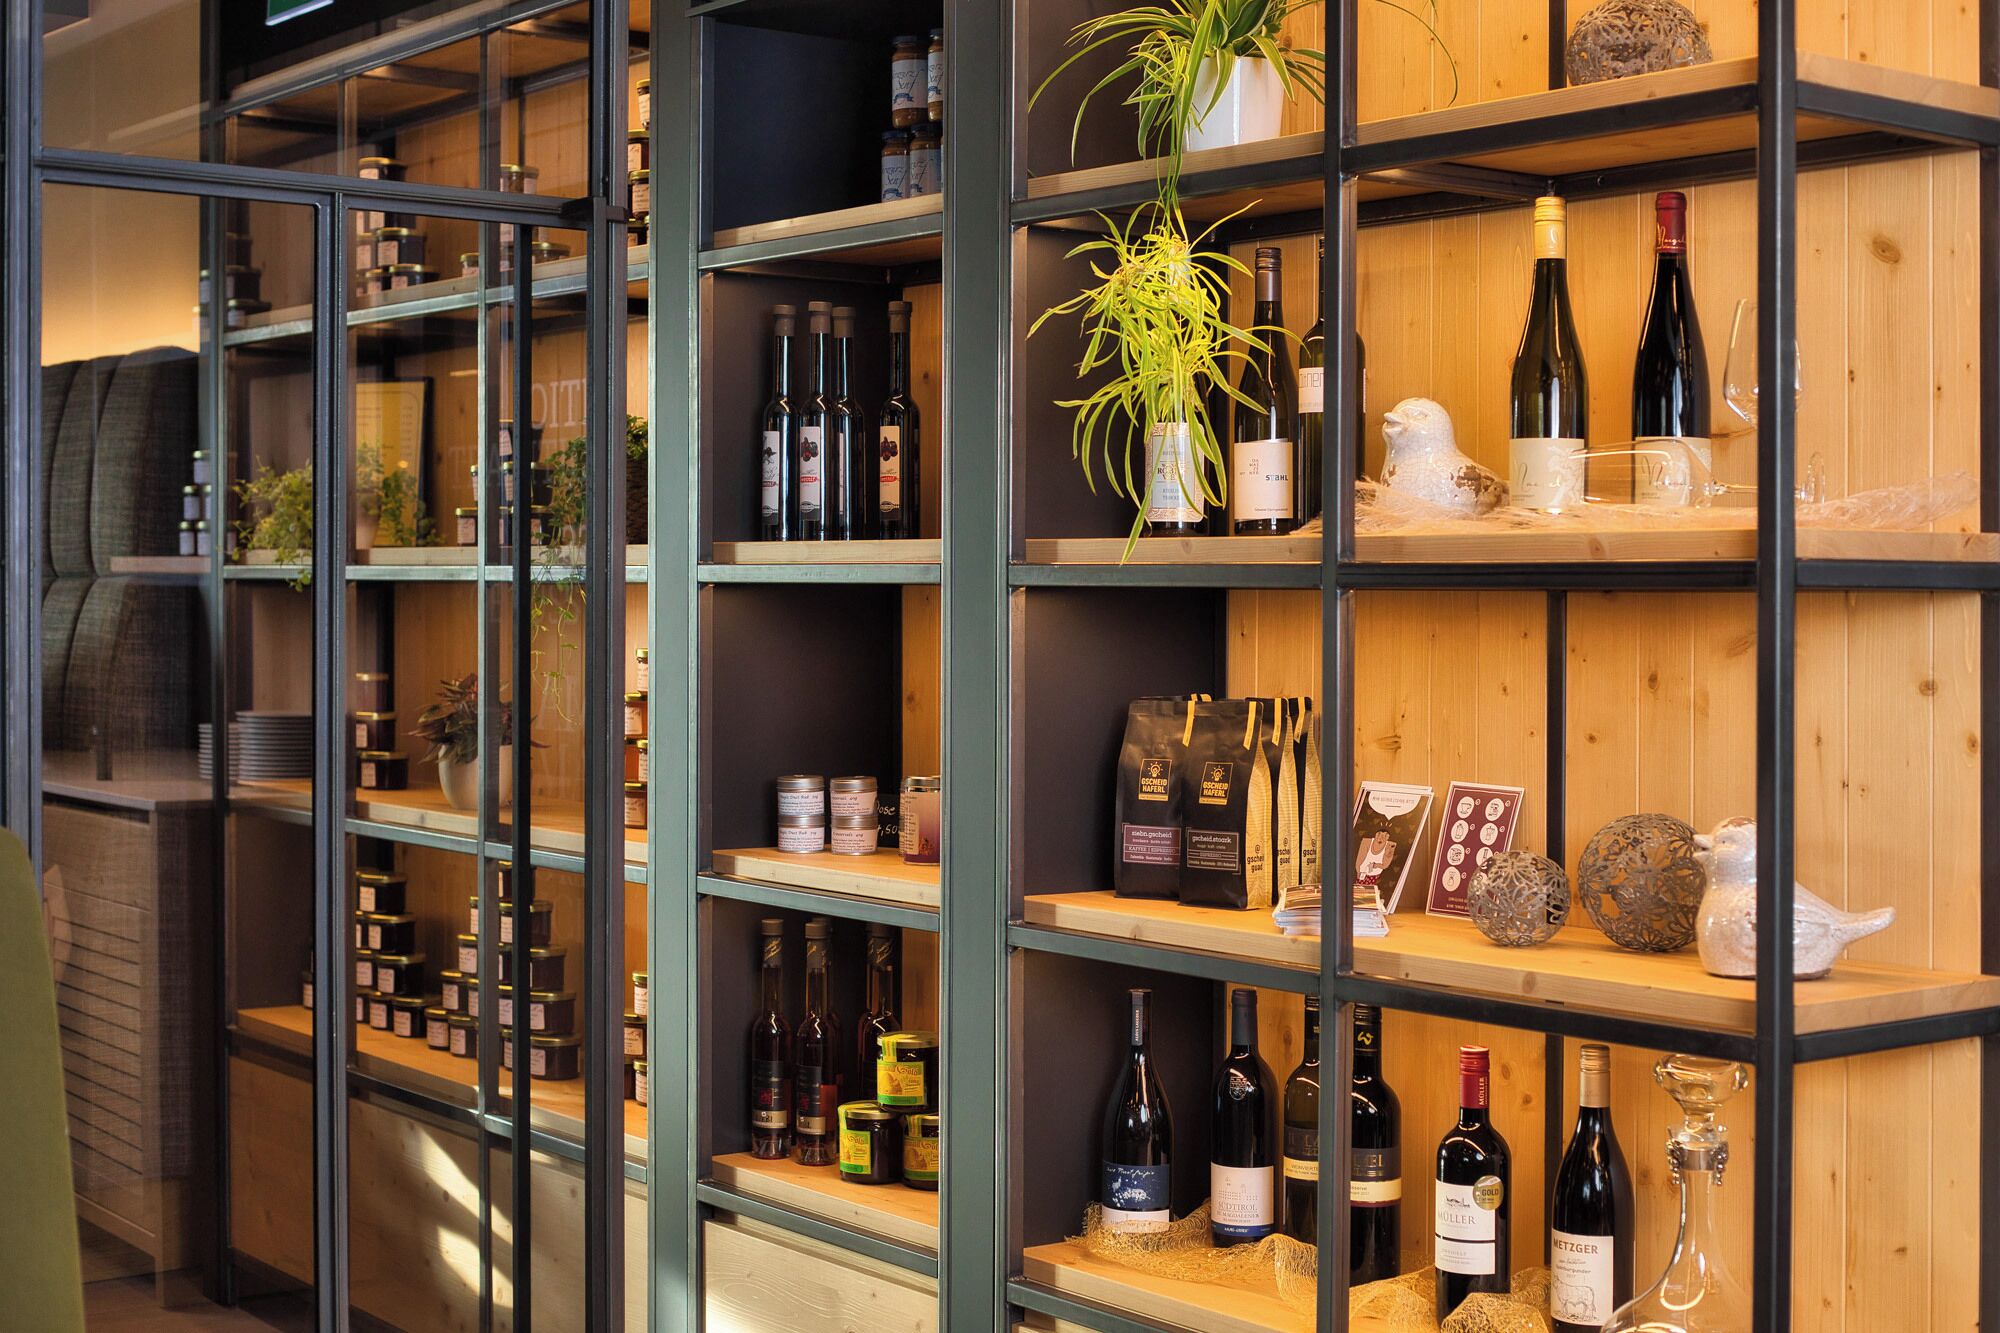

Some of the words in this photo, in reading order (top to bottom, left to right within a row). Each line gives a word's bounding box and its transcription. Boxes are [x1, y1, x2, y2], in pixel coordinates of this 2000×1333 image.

[1141, 778, 1168, 786] GSCHEID
[1203, 781, 1228, 790] GSCHEID
[1142, 785, 1166, 793] HAFERL
[1203, 789, 1226, 797] HAFERL
[1482, 1188, 1499, 1196] GOLD
[1553, 1237, 1599, 1254] METZGER
